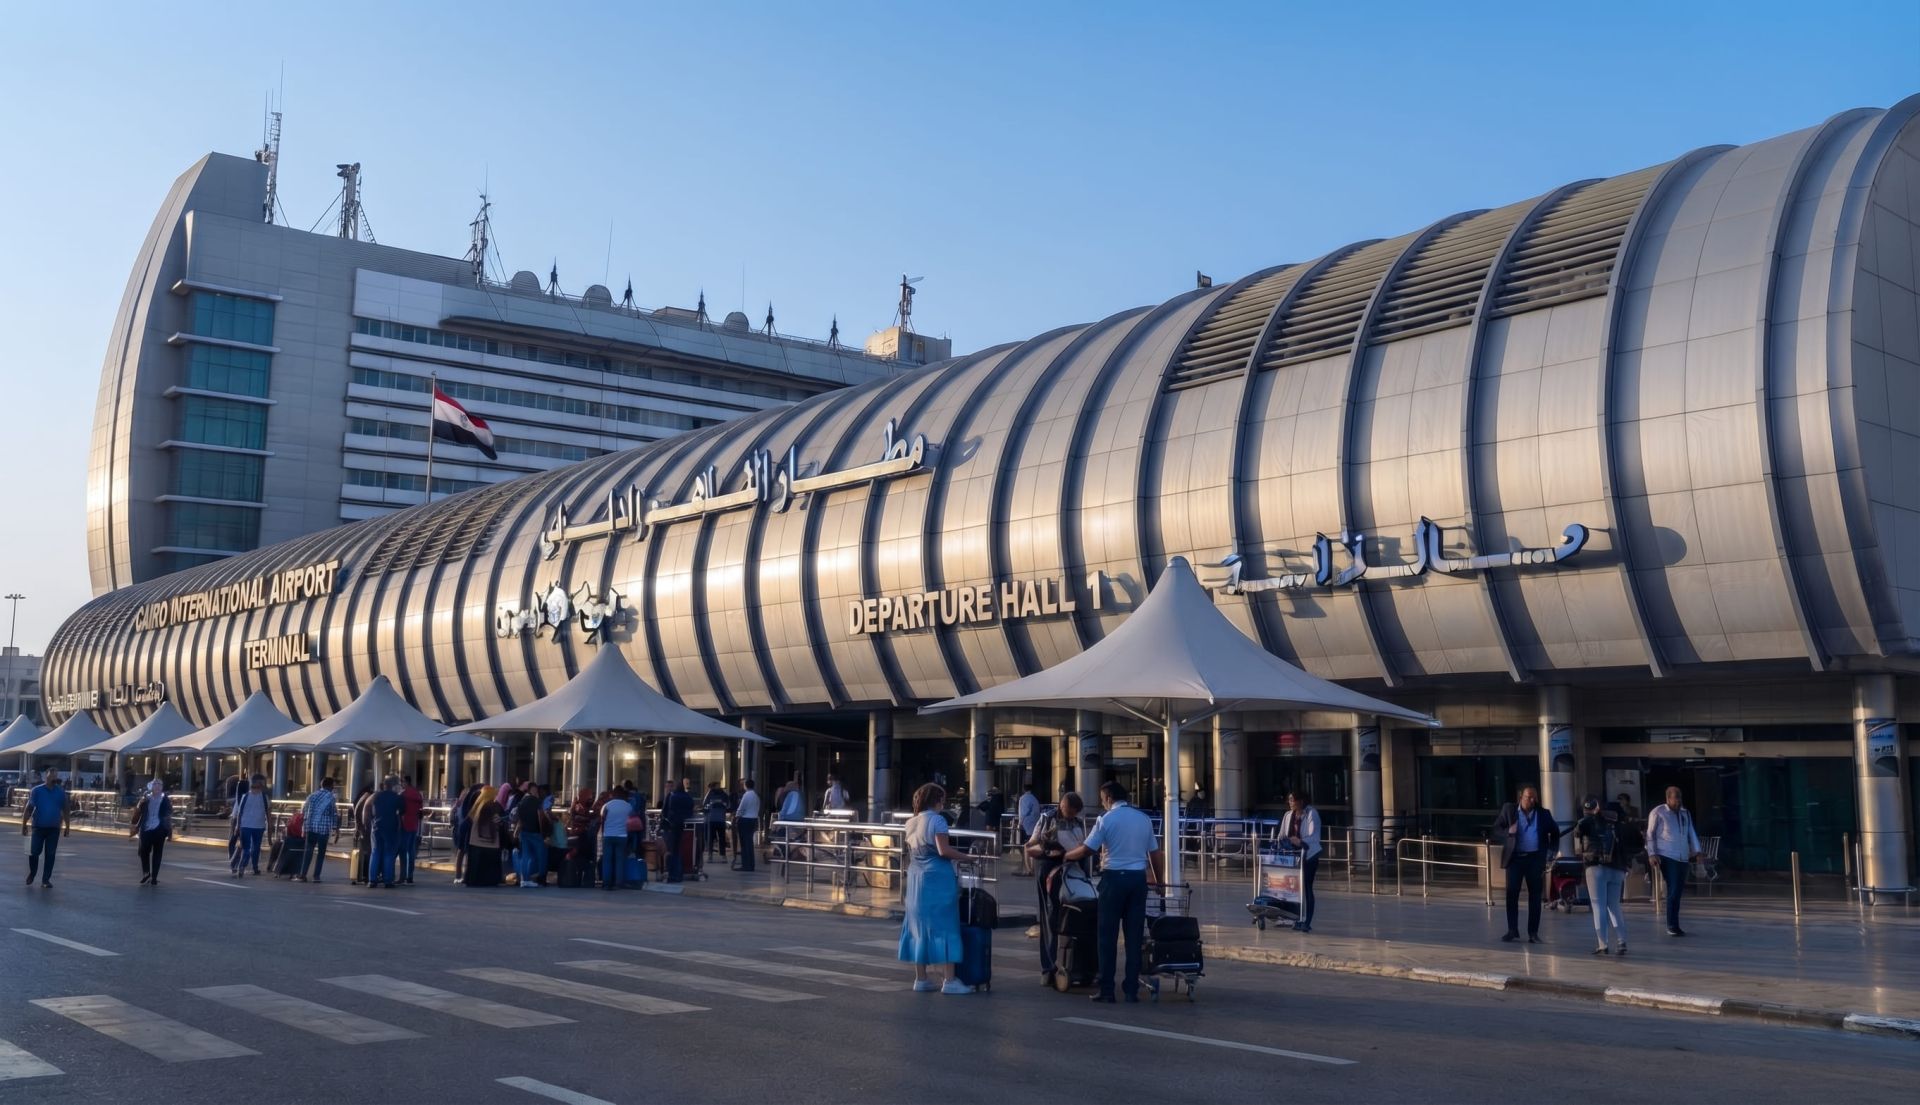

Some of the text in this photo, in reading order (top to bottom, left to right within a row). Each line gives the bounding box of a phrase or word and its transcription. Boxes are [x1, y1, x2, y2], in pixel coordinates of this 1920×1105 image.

[135, 560, 340, 633] CAIRO INTERNATIONAL AIRPORT
[849, 570, 1102, 635] DEPARTURE HALL 1
[244, 632, 310, 671] TERMINAL
